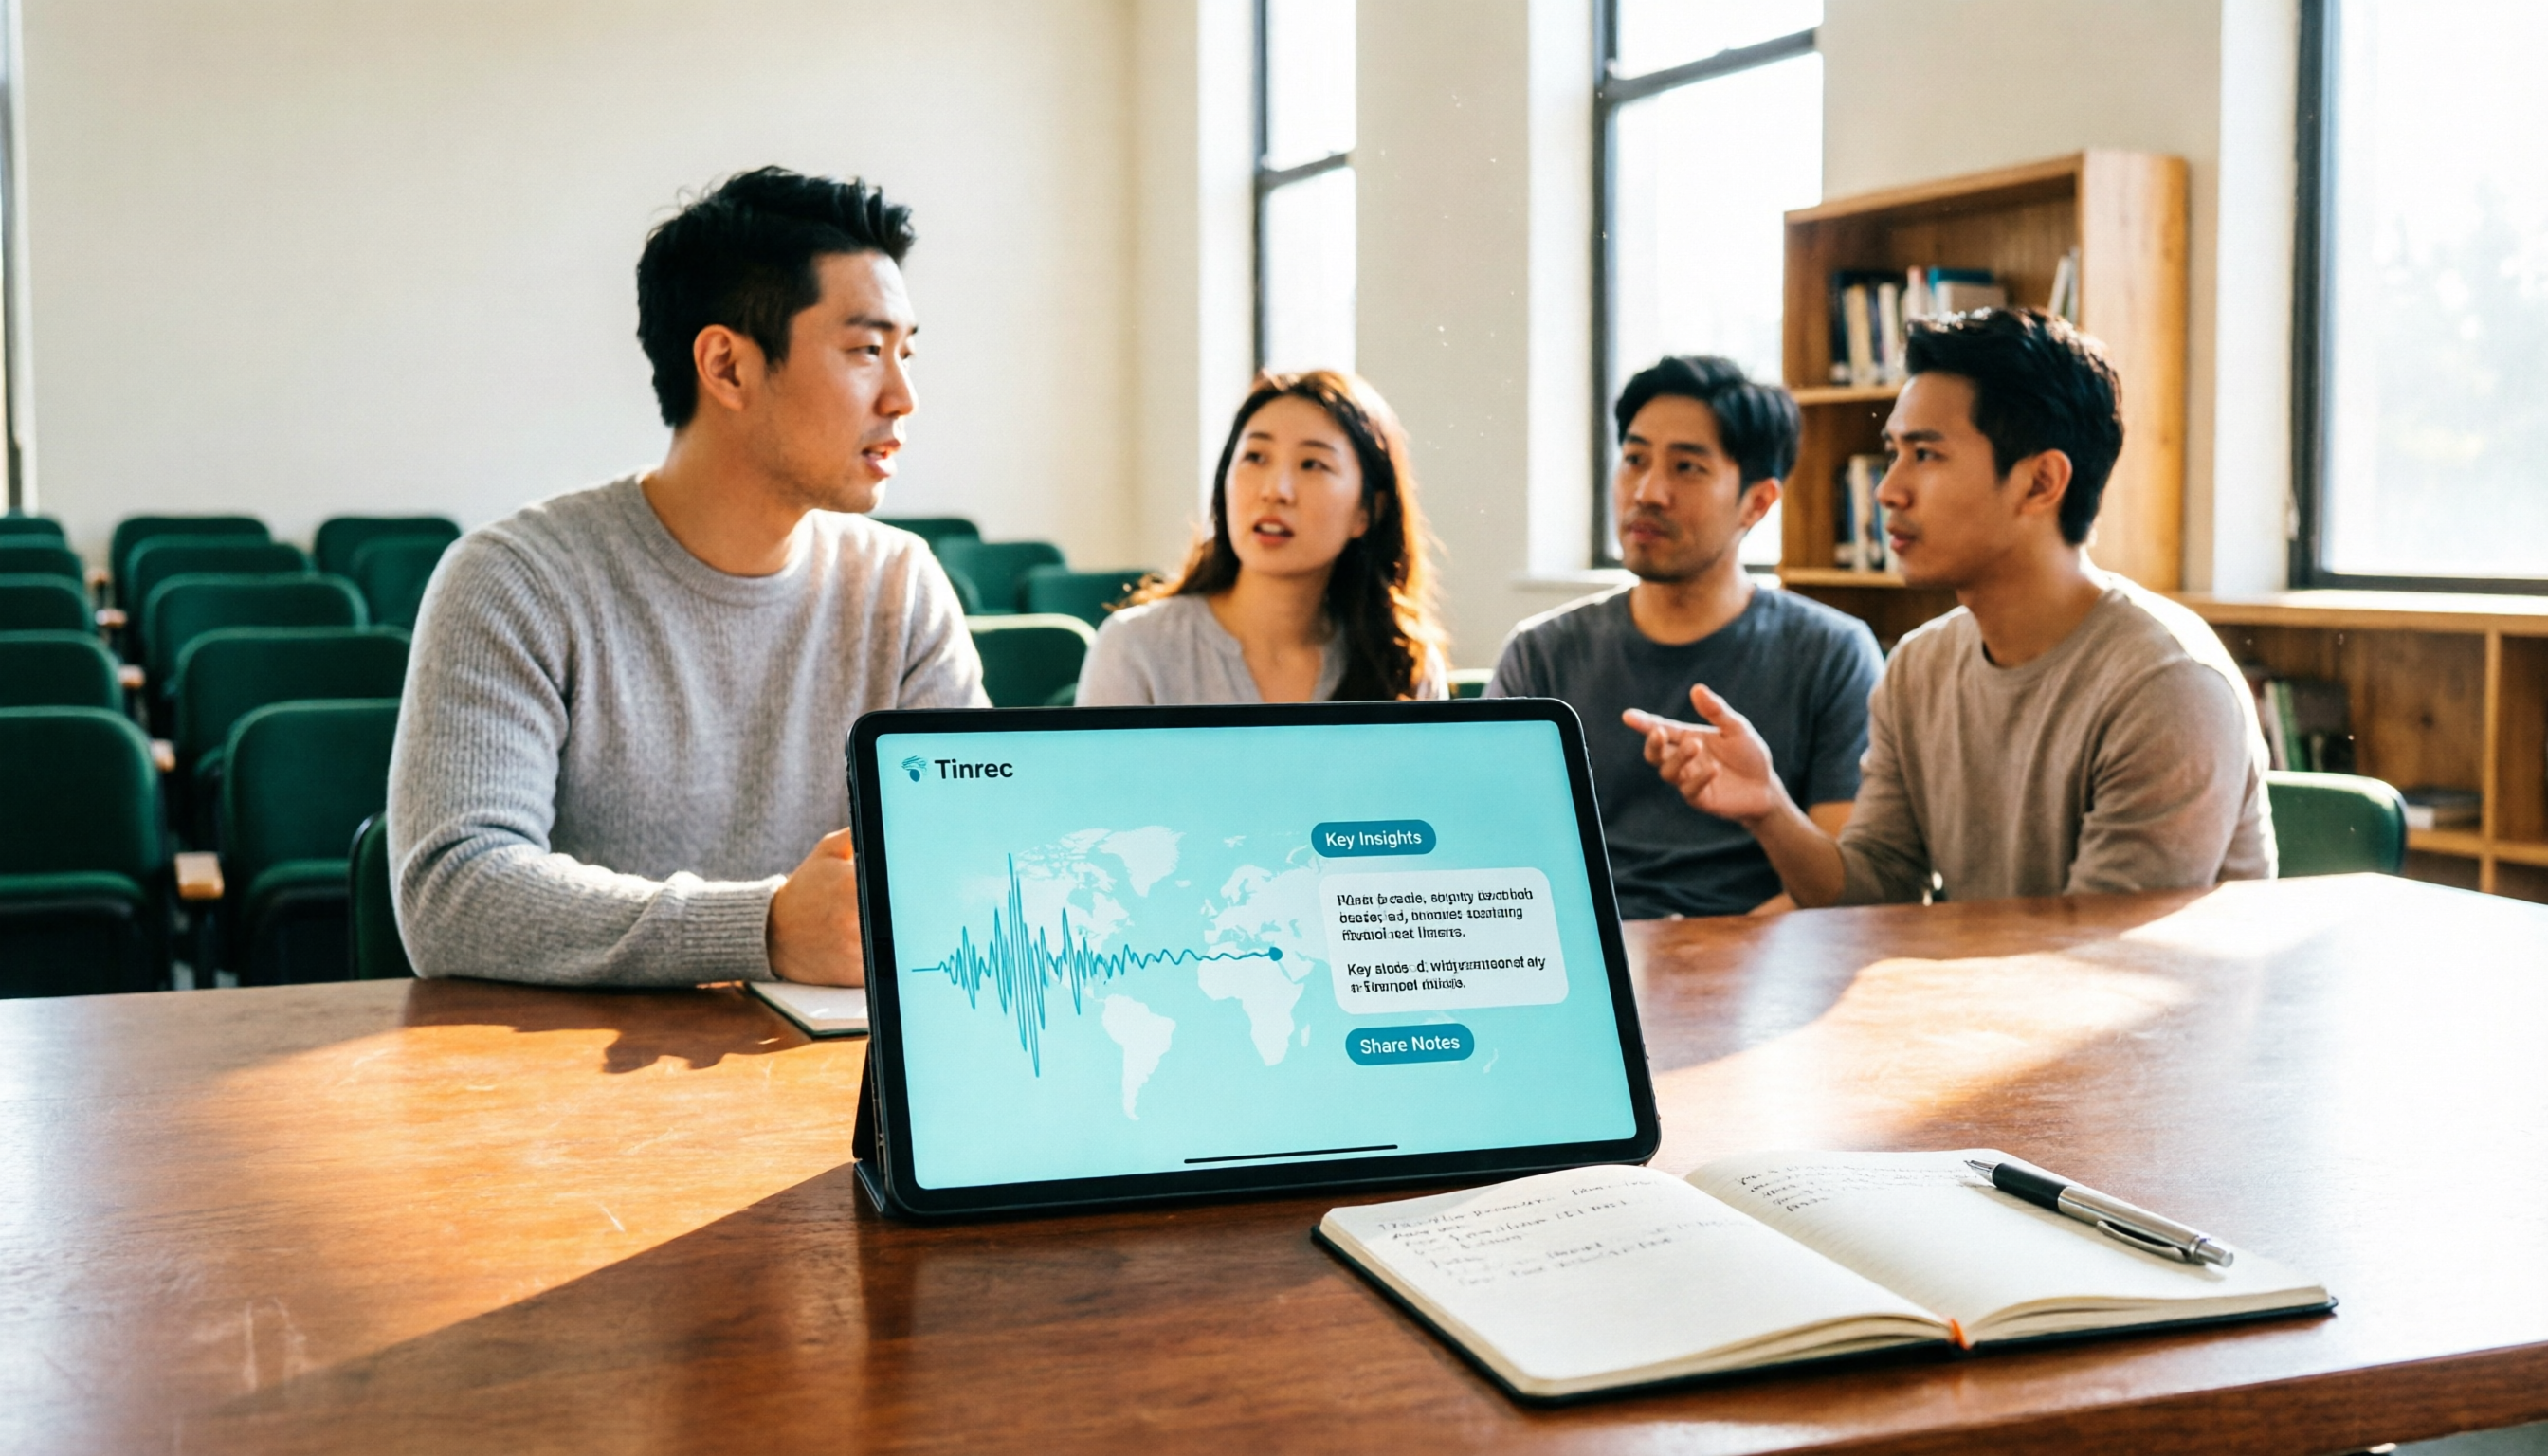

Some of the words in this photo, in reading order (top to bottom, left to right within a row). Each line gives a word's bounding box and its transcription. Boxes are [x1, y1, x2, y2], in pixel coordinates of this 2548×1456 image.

[934, 758, 1014, 779] Tinrec
[1325, 832, 1355, 850] Key
[1358, 829, 1423, 848] Insights
[1347, 963, 1372, 977] Key
[1360, 1038, 1408, 1054] Share
[1411, 1035, 1461, 1051] Notes
